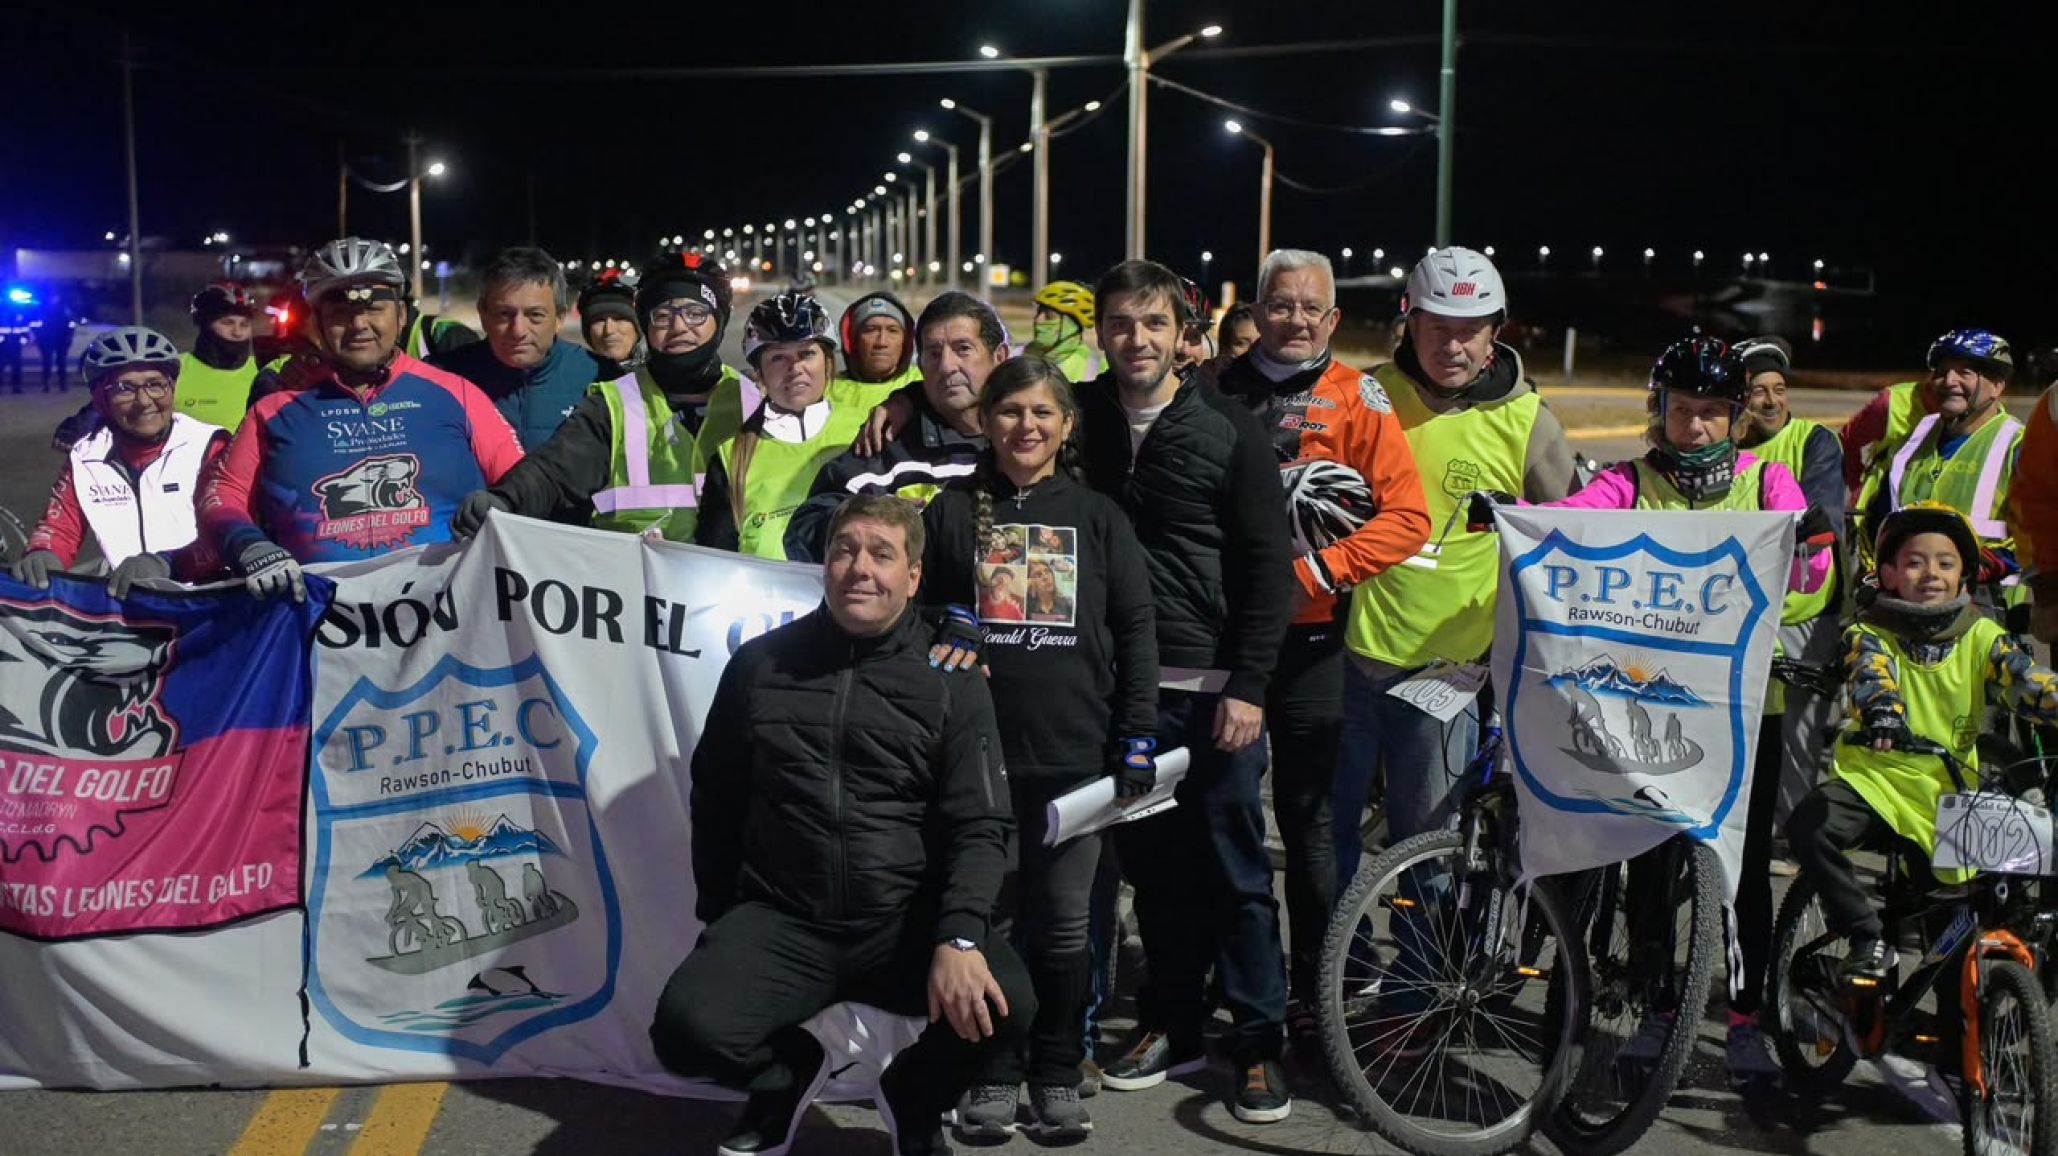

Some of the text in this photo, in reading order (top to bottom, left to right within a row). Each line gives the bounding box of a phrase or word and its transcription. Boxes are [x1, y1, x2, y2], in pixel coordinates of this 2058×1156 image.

[327, 417, 405, 438] SVANE
[320, 518, 364, 537] LEONES
[391, 510, 427, 526] GOLFO
[495, 567, 624, 644] POR
[644, 595, 701, 659] EL
[1568, 606, 1701, 635] Rawson-Chubut
[1026, 627, 1077, 651] Guerra
[7, 760, 172, 802] DEL GOLFO
[380, 756, 532, 794] Rawson-Chubut
[155, 873, 201, 905] DEL
